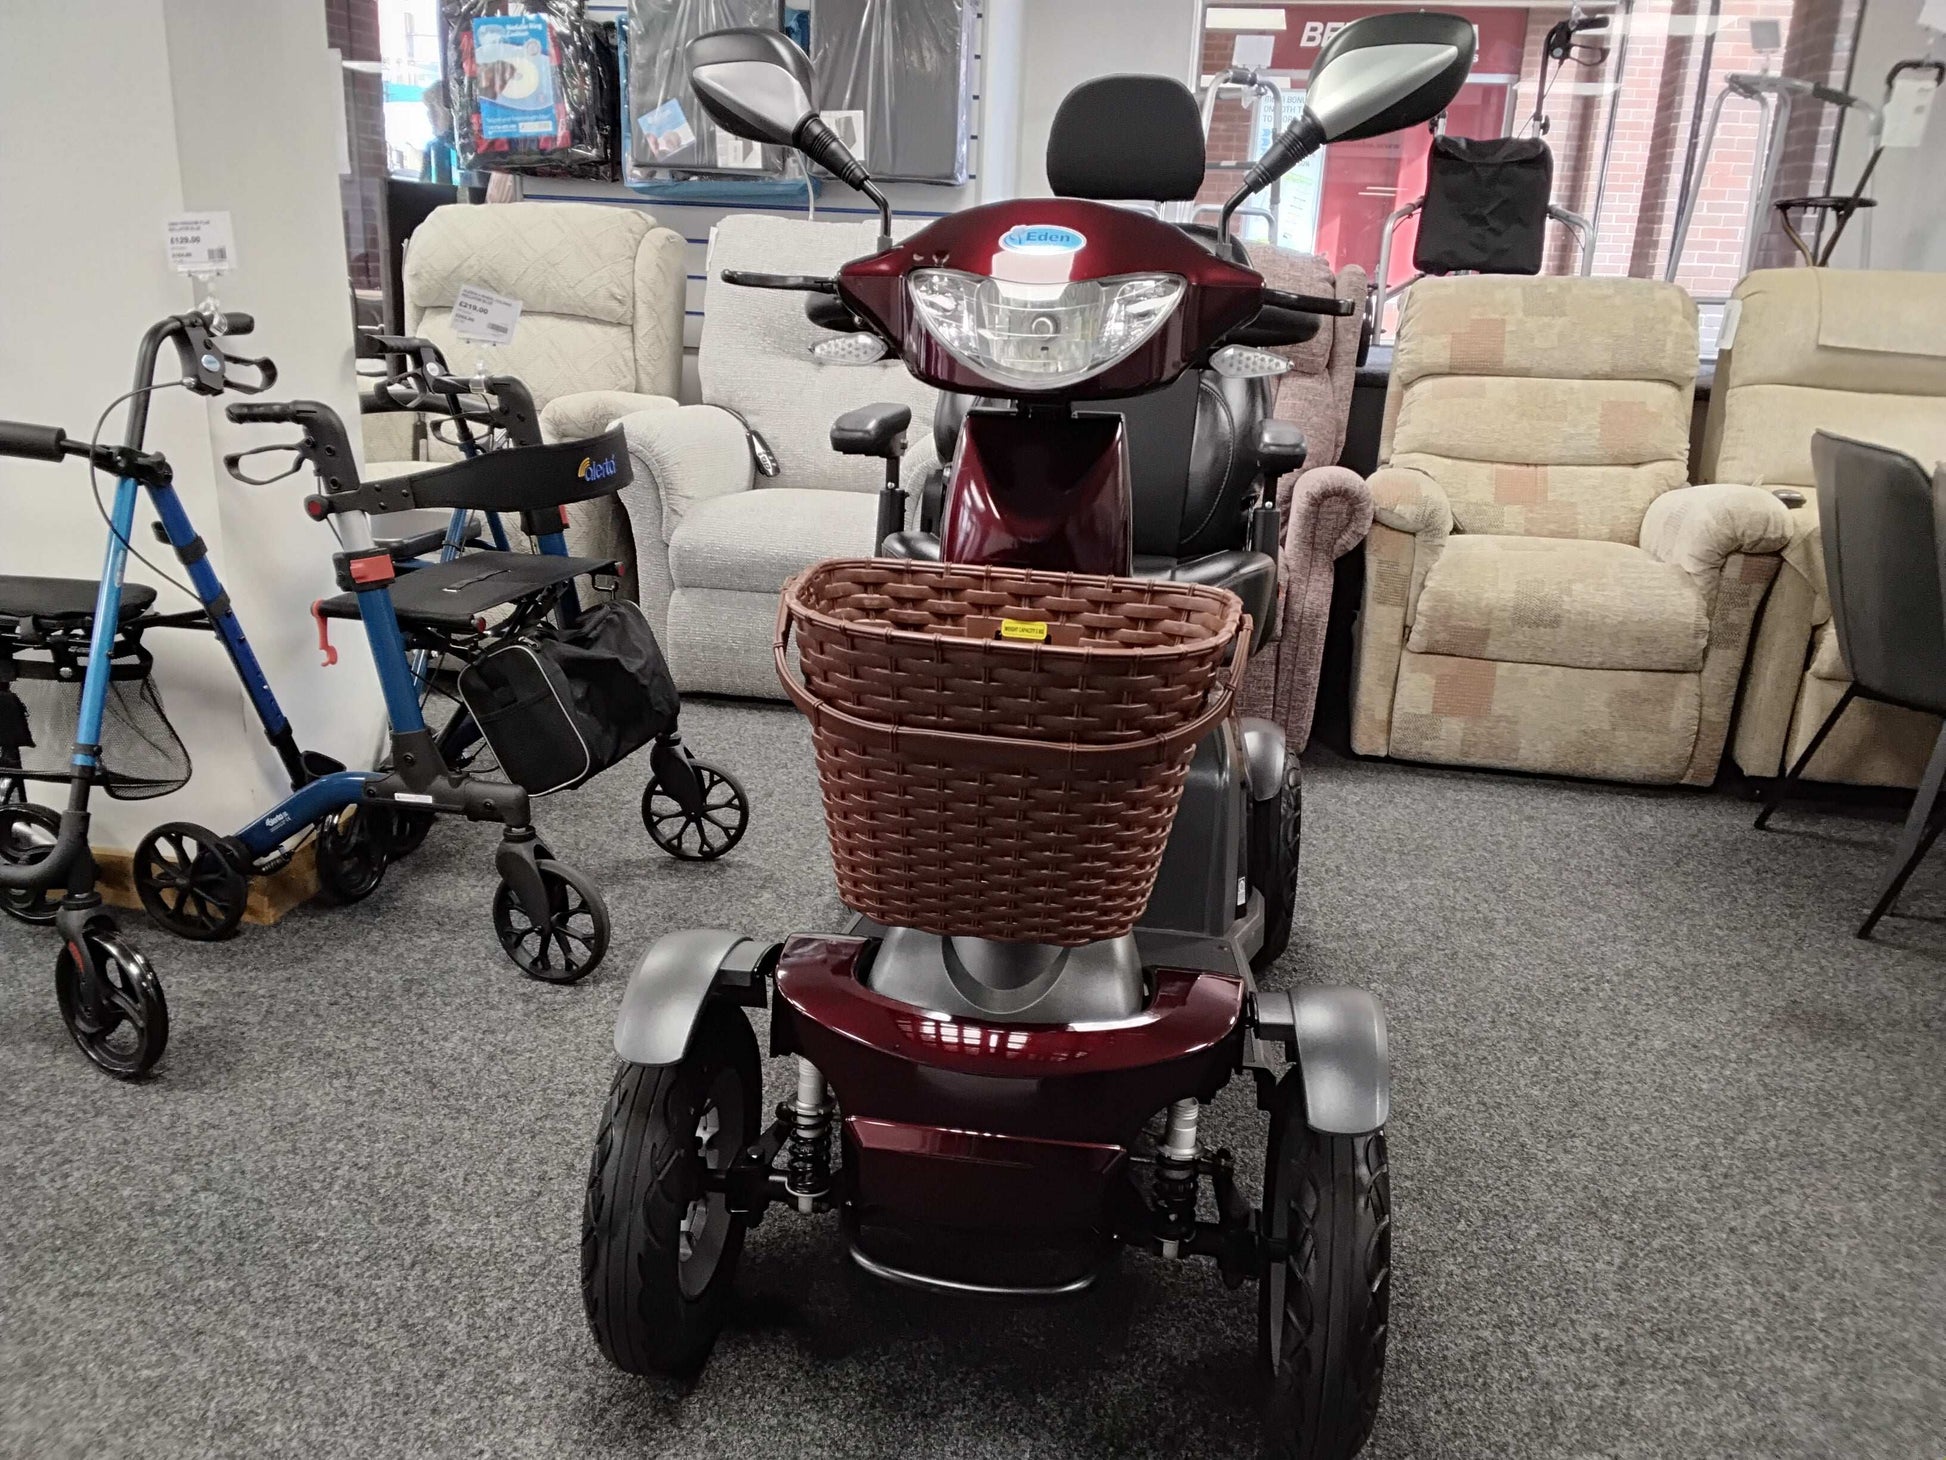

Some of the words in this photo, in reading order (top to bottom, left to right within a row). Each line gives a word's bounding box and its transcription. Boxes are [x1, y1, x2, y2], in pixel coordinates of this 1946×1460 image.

[170, 236, 201, 245] £129.00
[1026, 231, 1071, 242] Eden
[459, 301, 489, 315] £219.00
